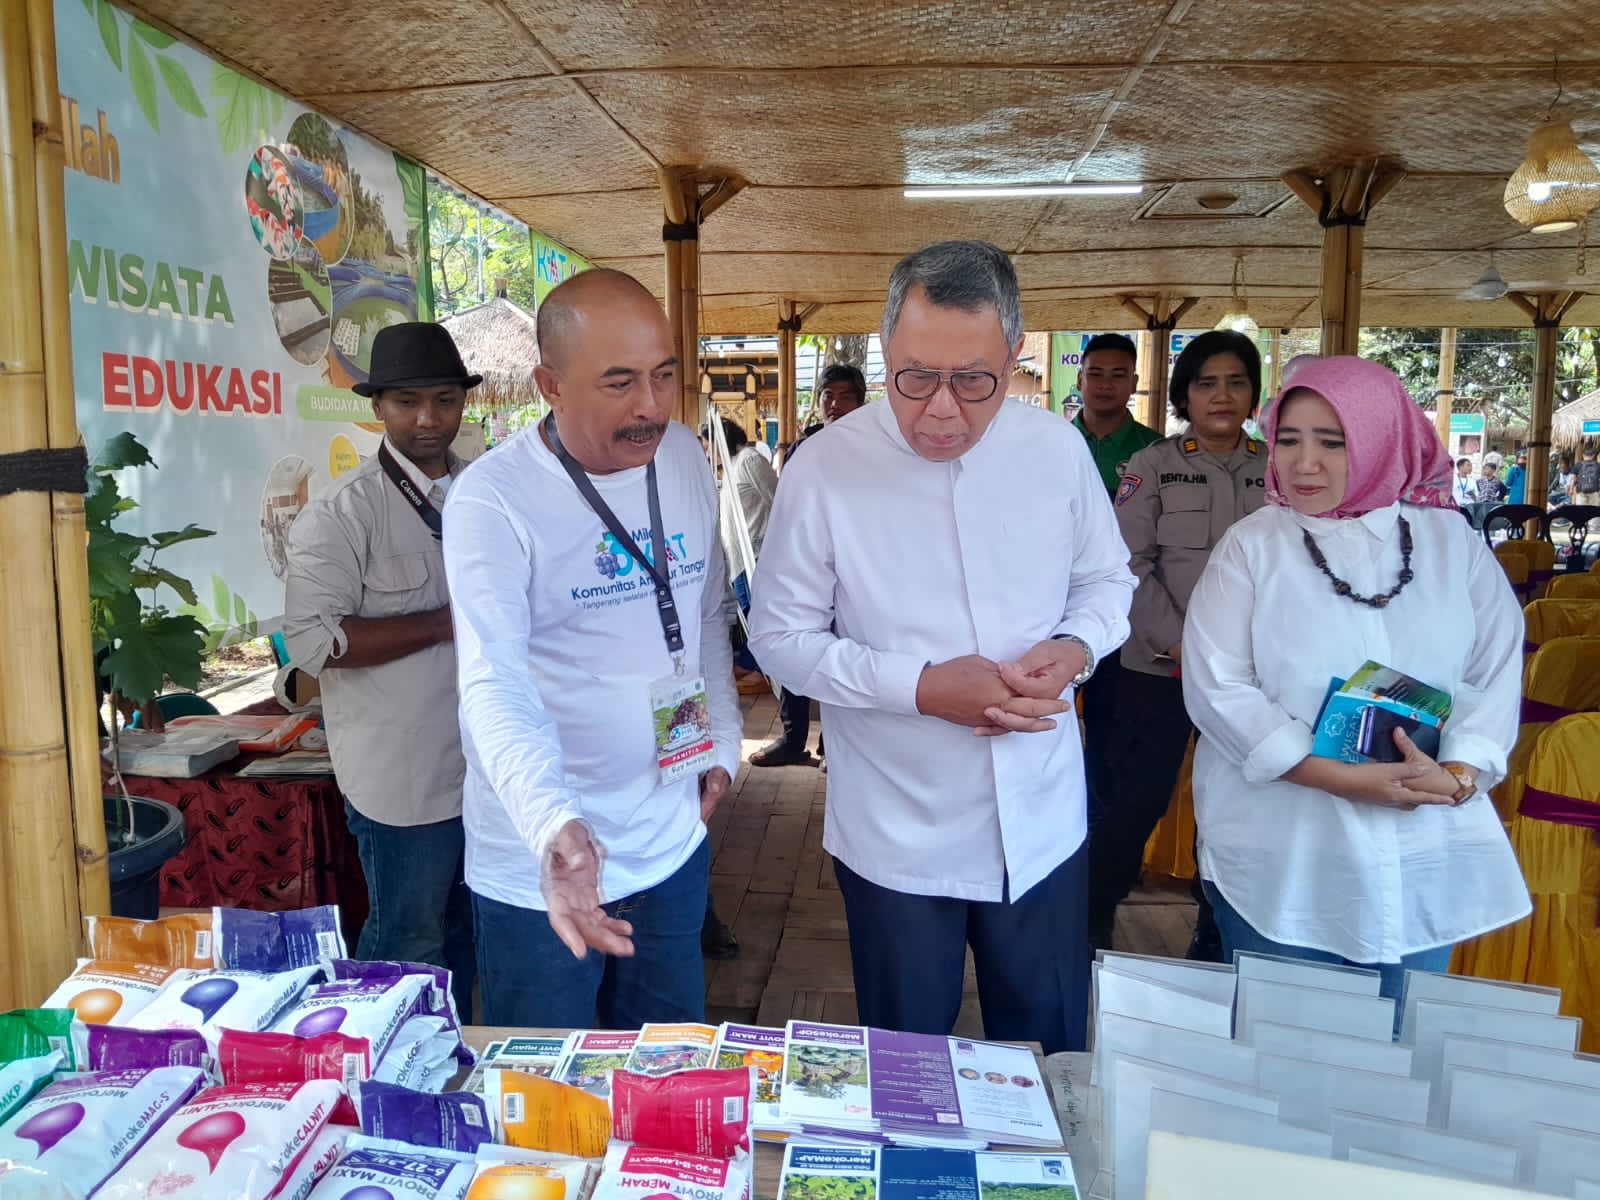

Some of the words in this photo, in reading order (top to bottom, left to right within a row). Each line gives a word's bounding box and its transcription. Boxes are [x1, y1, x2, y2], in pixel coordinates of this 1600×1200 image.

[102, 352, 283, 416] EDUKASI
[310, 396, 361, 412] BUDIDAYA
[400, 480, 423, 506] Canon
[571, 580, 637, 601] Komunitas
[372, 997, 408, 1056] MerokeSOP
[178, 1100, 287, 1117] MerokeCALNIT
[110, 1090, 170, 1159] MerokeMAG-S
[798, 1155, 871, 1164] MerokeMAP
[332, 1167, 377, 1182] MAXI
[620, 1176, 671, 1191] MERAH
[377, 1176, 437, 1200] PROVIT
[674, 1185, 724, 1200] PROVIT
